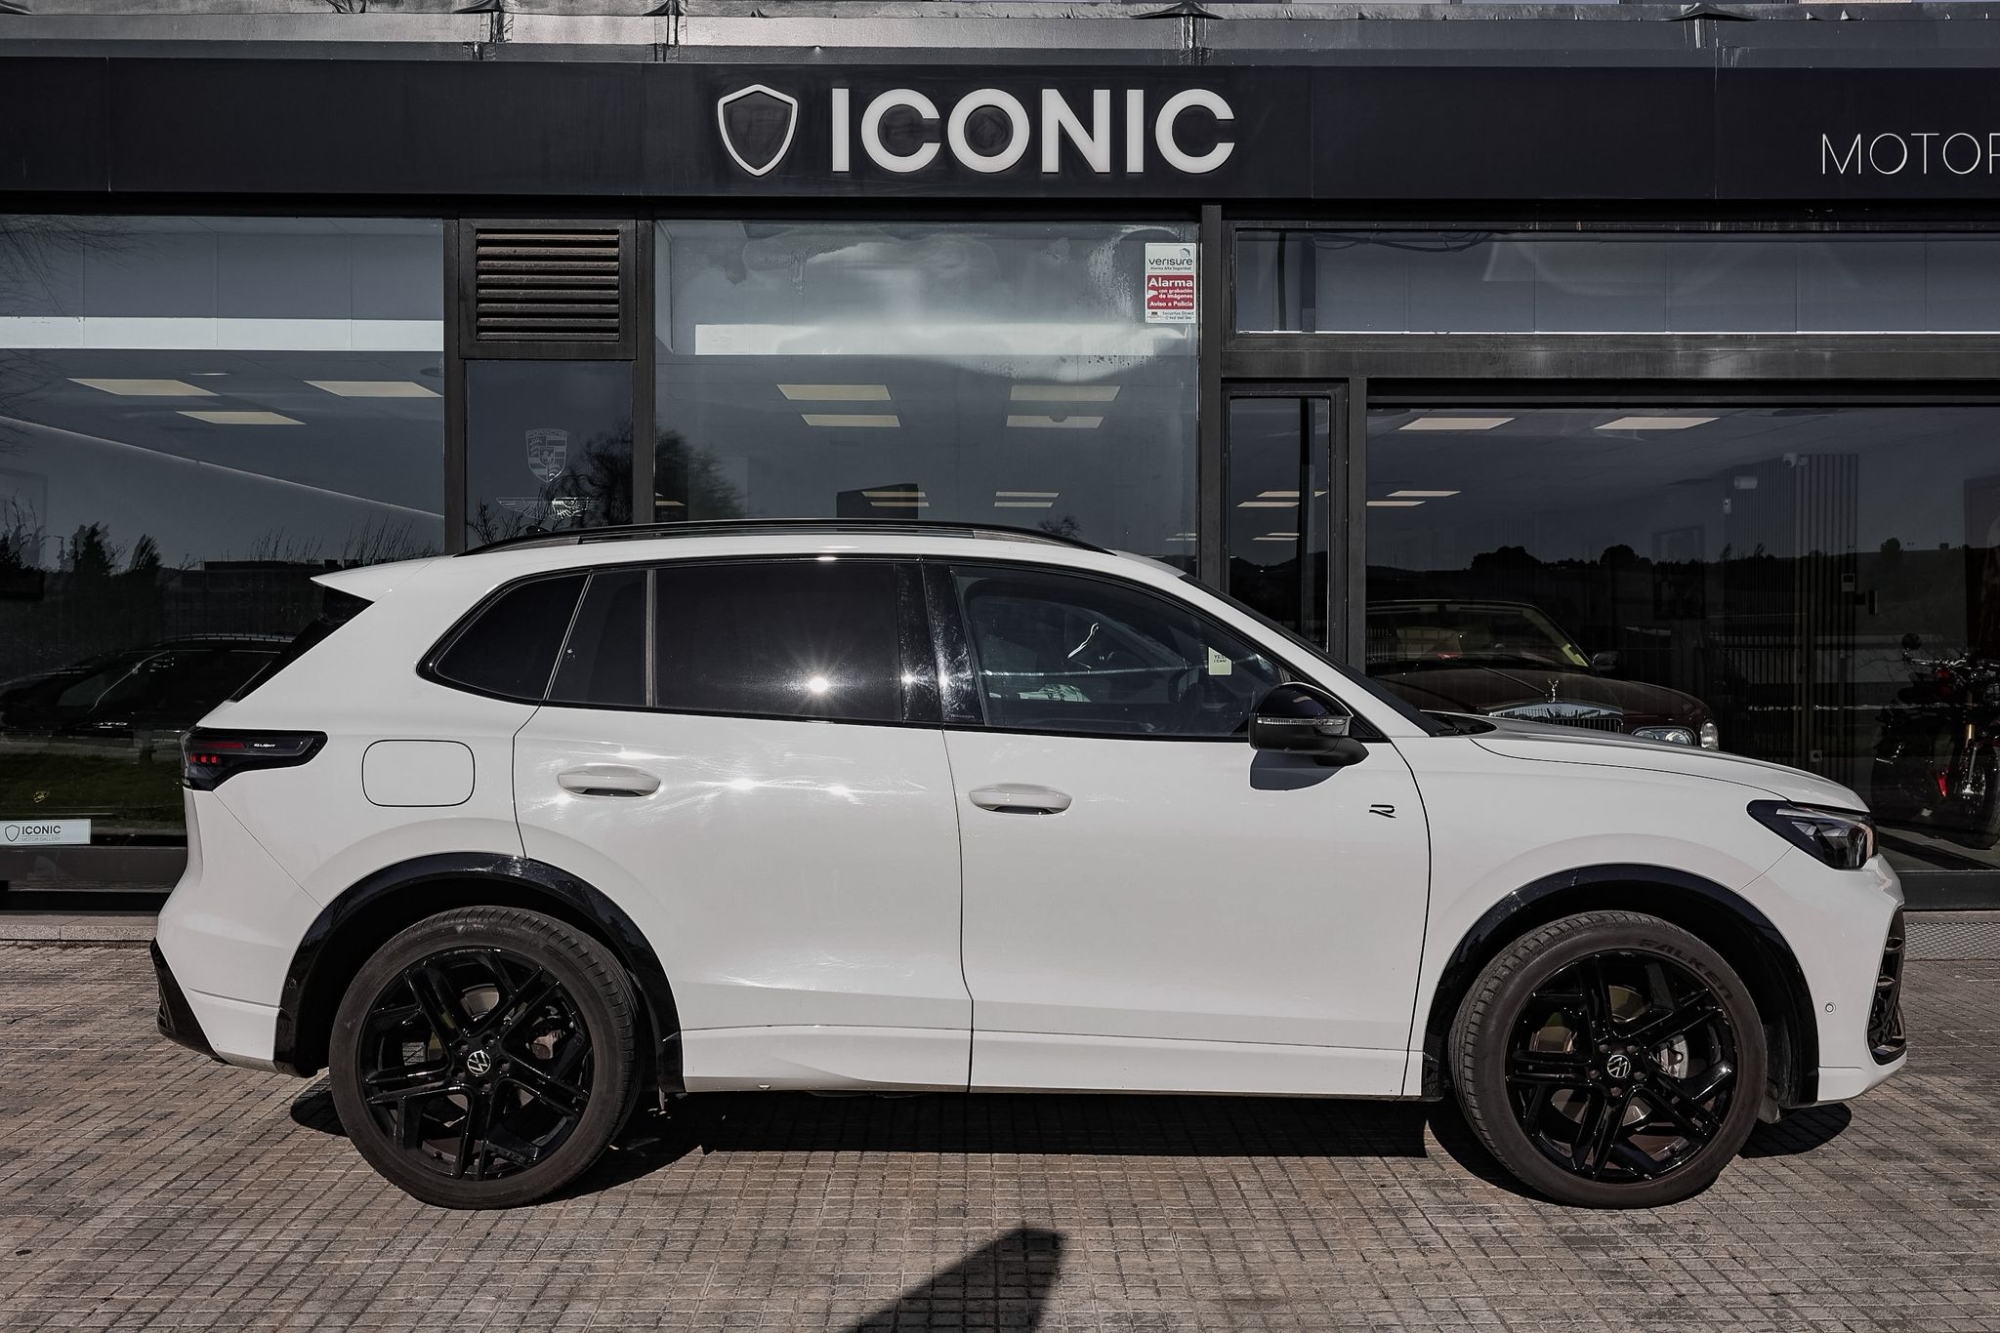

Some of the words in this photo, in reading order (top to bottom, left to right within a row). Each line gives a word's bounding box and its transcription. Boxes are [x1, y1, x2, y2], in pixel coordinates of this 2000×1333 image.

[832, 88, 1235, 173] ICONIC
[1148, 258, 1193, 266] verisure
[1148, 277, 1193, 287] Alarma
[1369, 804, 1397, 819] R
[22, 825, 61, 835] ICONIC
